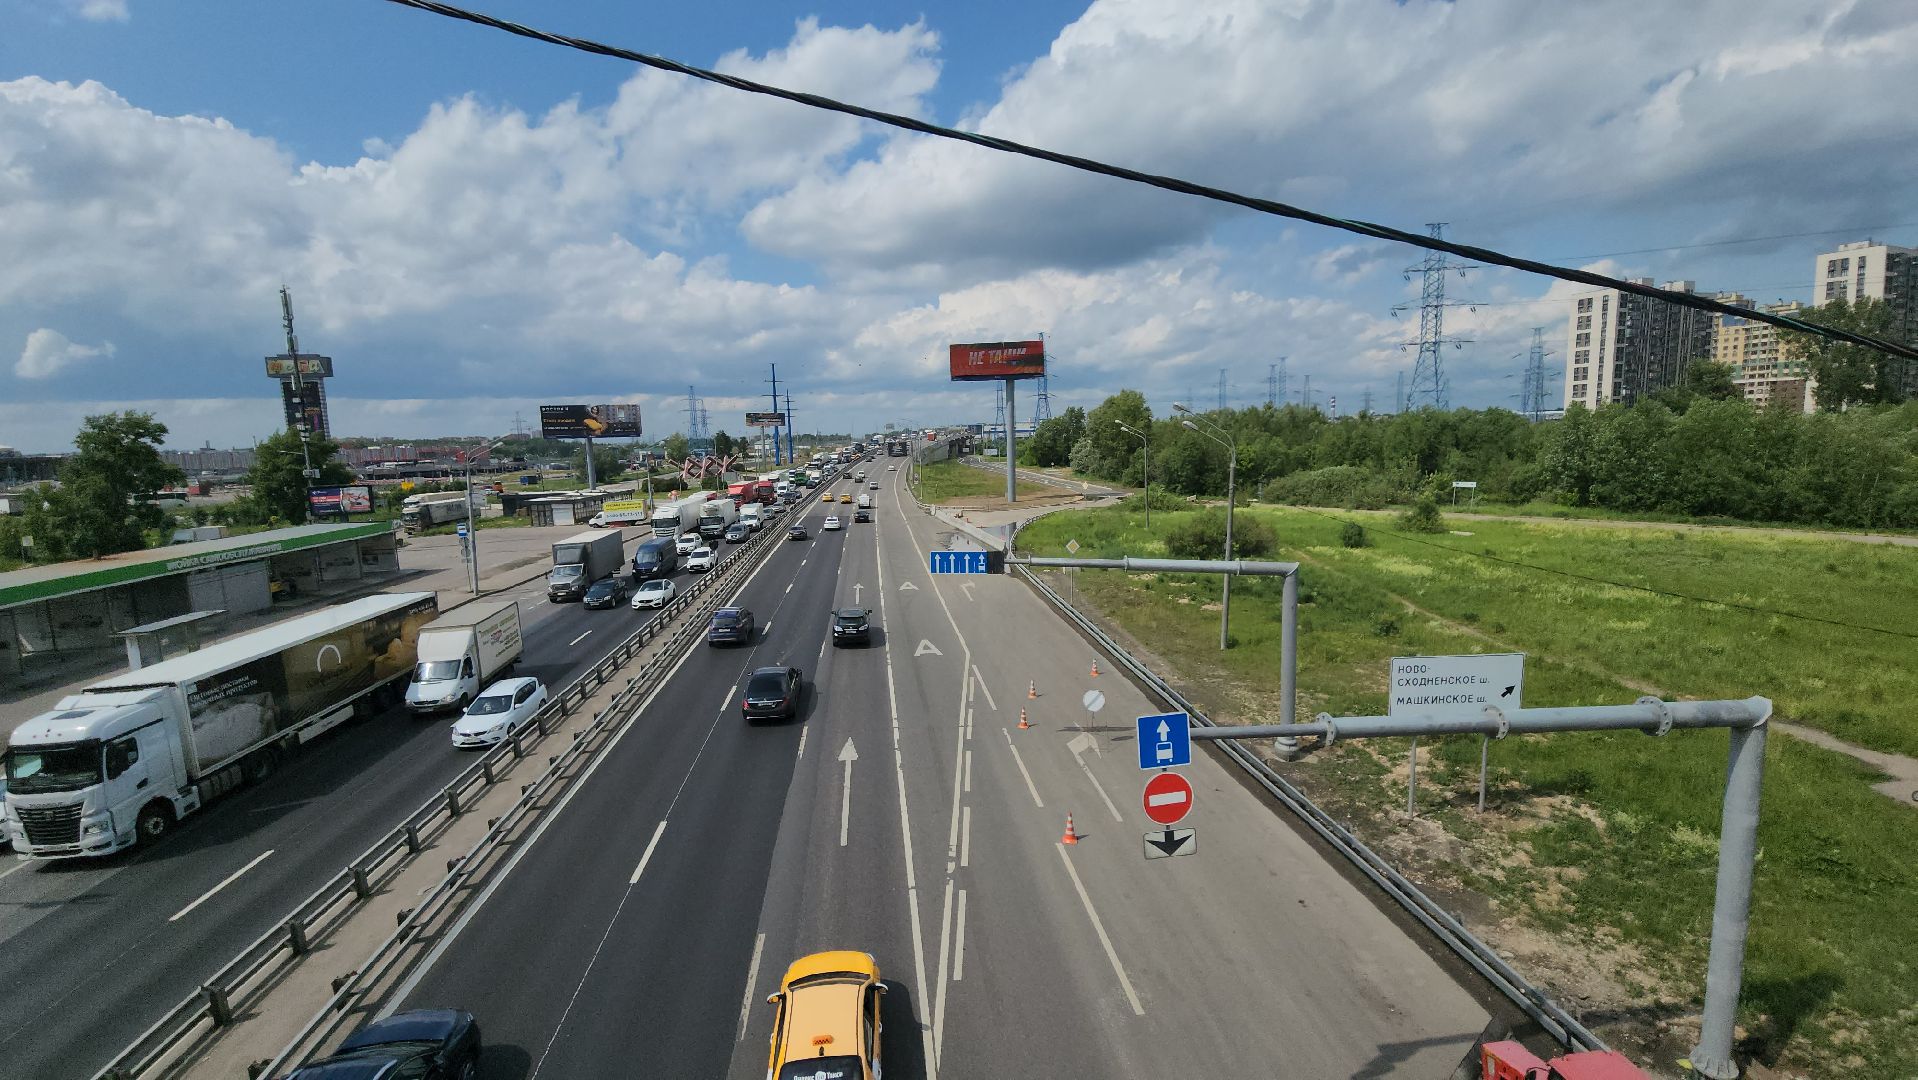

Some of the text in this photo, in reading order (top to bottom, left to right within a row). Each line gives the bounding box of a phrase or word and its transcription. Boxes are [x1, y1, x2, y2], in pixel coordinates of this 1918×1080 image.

[969, 351, 986, 366] НЕ
[1398, 664, 1431, 674] НОВО-
[1398, 675, 1476, 687] СХОДНЕНСКОЕ
[1397, 695, 1474, 705] МАШКИНСКОЕ
